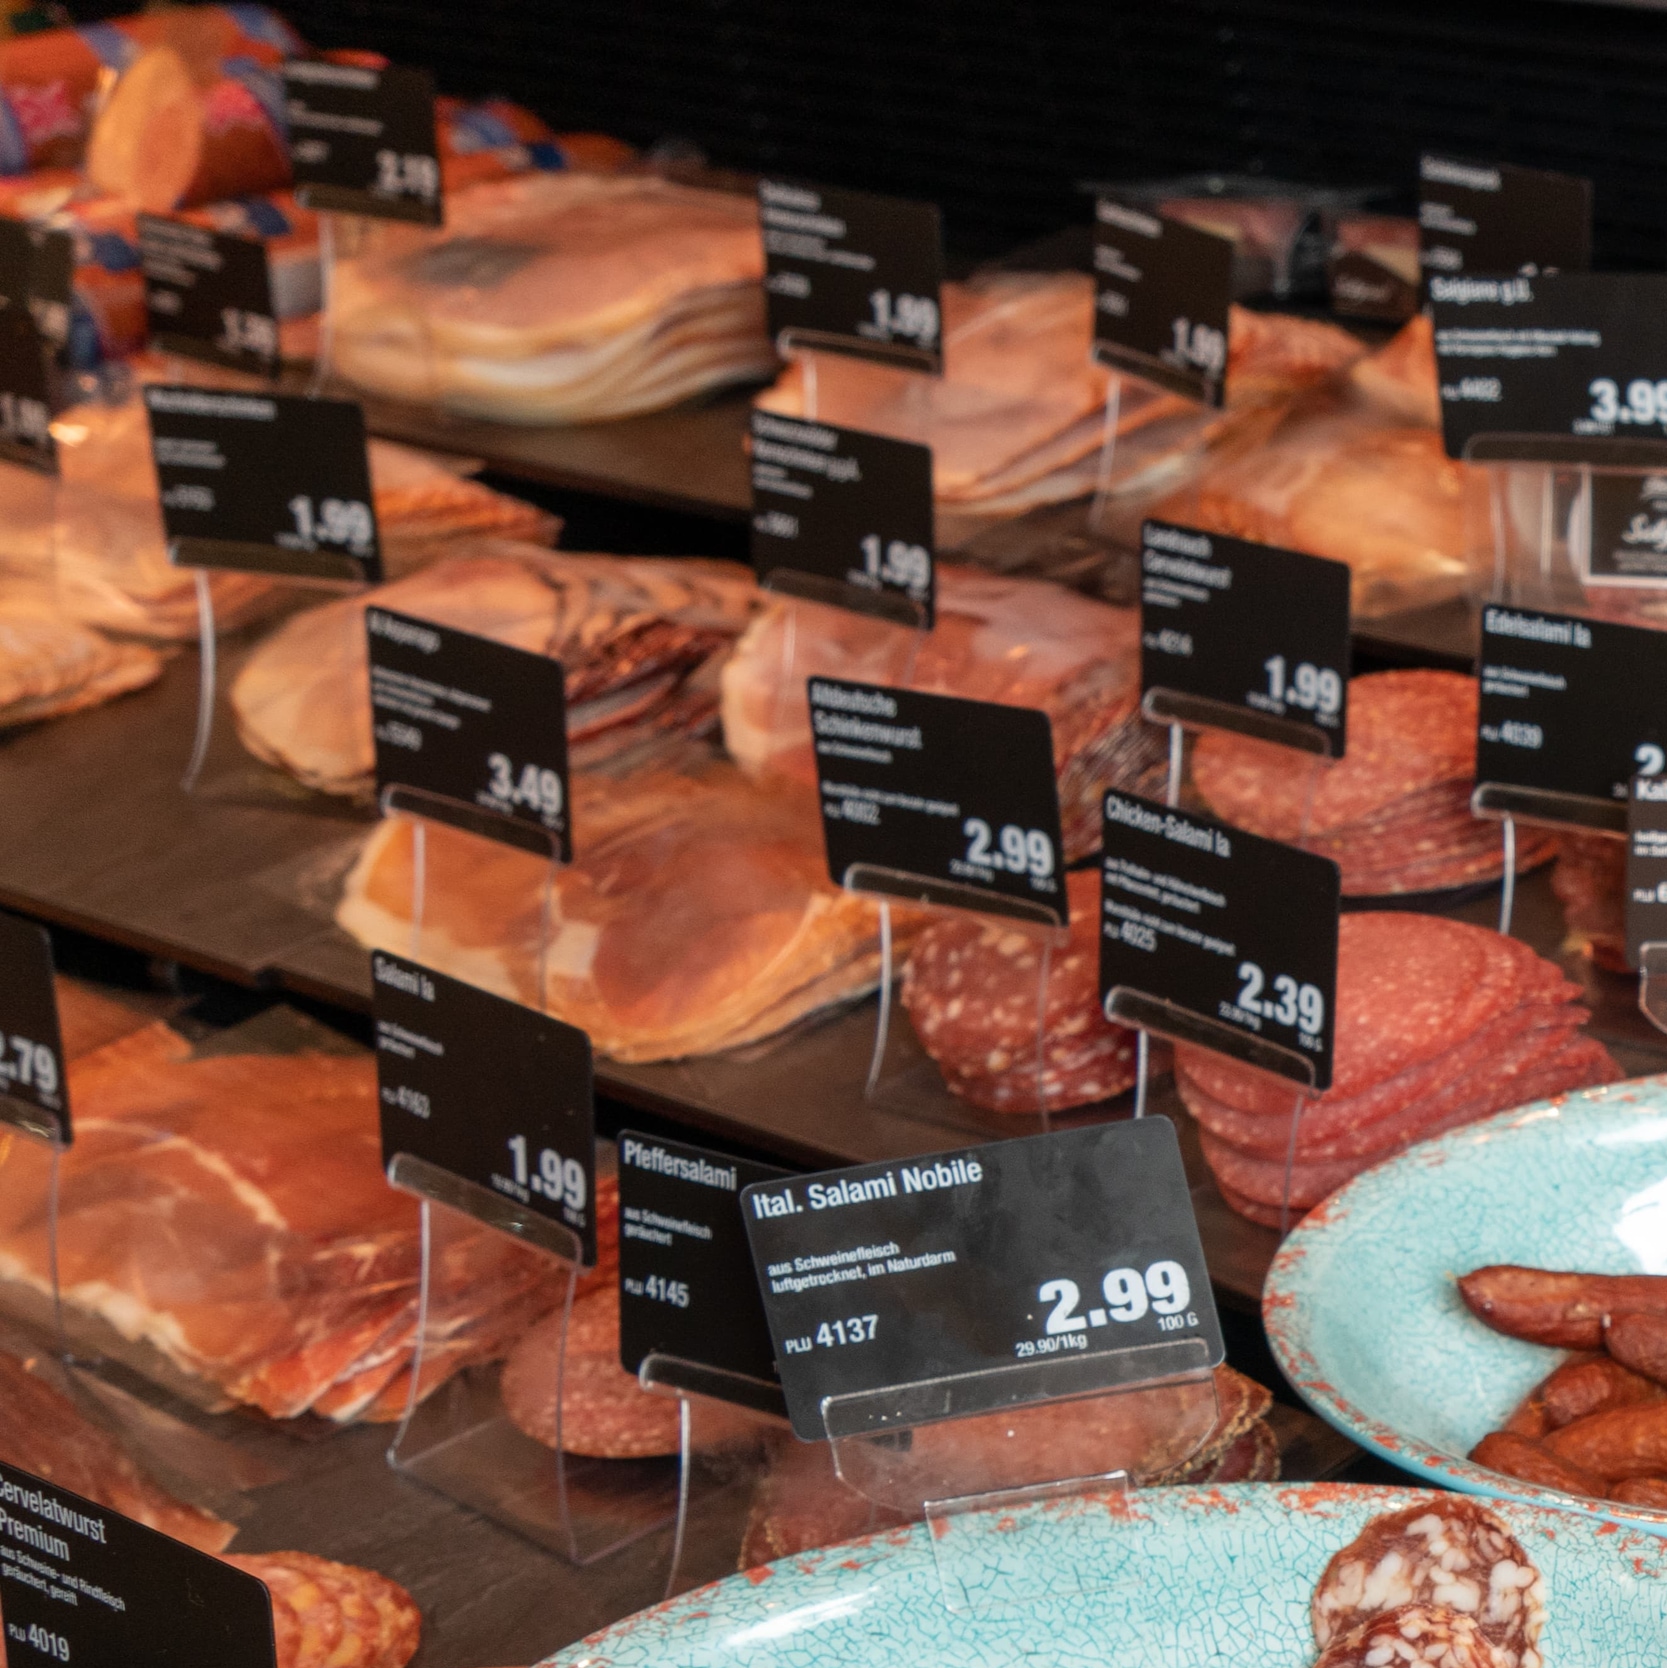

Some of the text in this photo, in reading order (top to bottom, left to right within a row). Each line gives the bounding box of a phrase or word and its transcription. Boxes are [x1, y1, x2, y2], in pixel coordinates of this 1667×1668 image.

[1485, 609, 1572, 643] Edelsalami
[1261, 656, 1341, 715] 1.99
[485, 753, 562, 817] 3.49
[960, 818, 1053, 882] 2.99
[1106, 796, 1213, 851] Chicken-Salami
[1234, 962, 1323, 1034] 2.39
[504, 1134, 586, 1213] 1.99
[623, 1138, 737, 1191] Pfeffersalami
[752, 1158, 983, 1219] Ital. Salami Nobile
[767, 1240, 900, 1276] aus Schweinefleisch
[771, 1250, 956, 1293] luftgetrocknet, im Naturdarm
[624, 1275, 690, 1308] PLU 4145
[1037, 1259, 1193, 1342] 2.99
[784, 1313, 879, 1354] PLU 4137
[1015, 1332, 1088, 1357] 29.90/1kg
[1157, 1311, 1199, 1331] 100 G
[0, 1544, 126, 1611] aus Schweine- und Rindfleisch
[7, 1622, 70, 1662] PLU 4019
